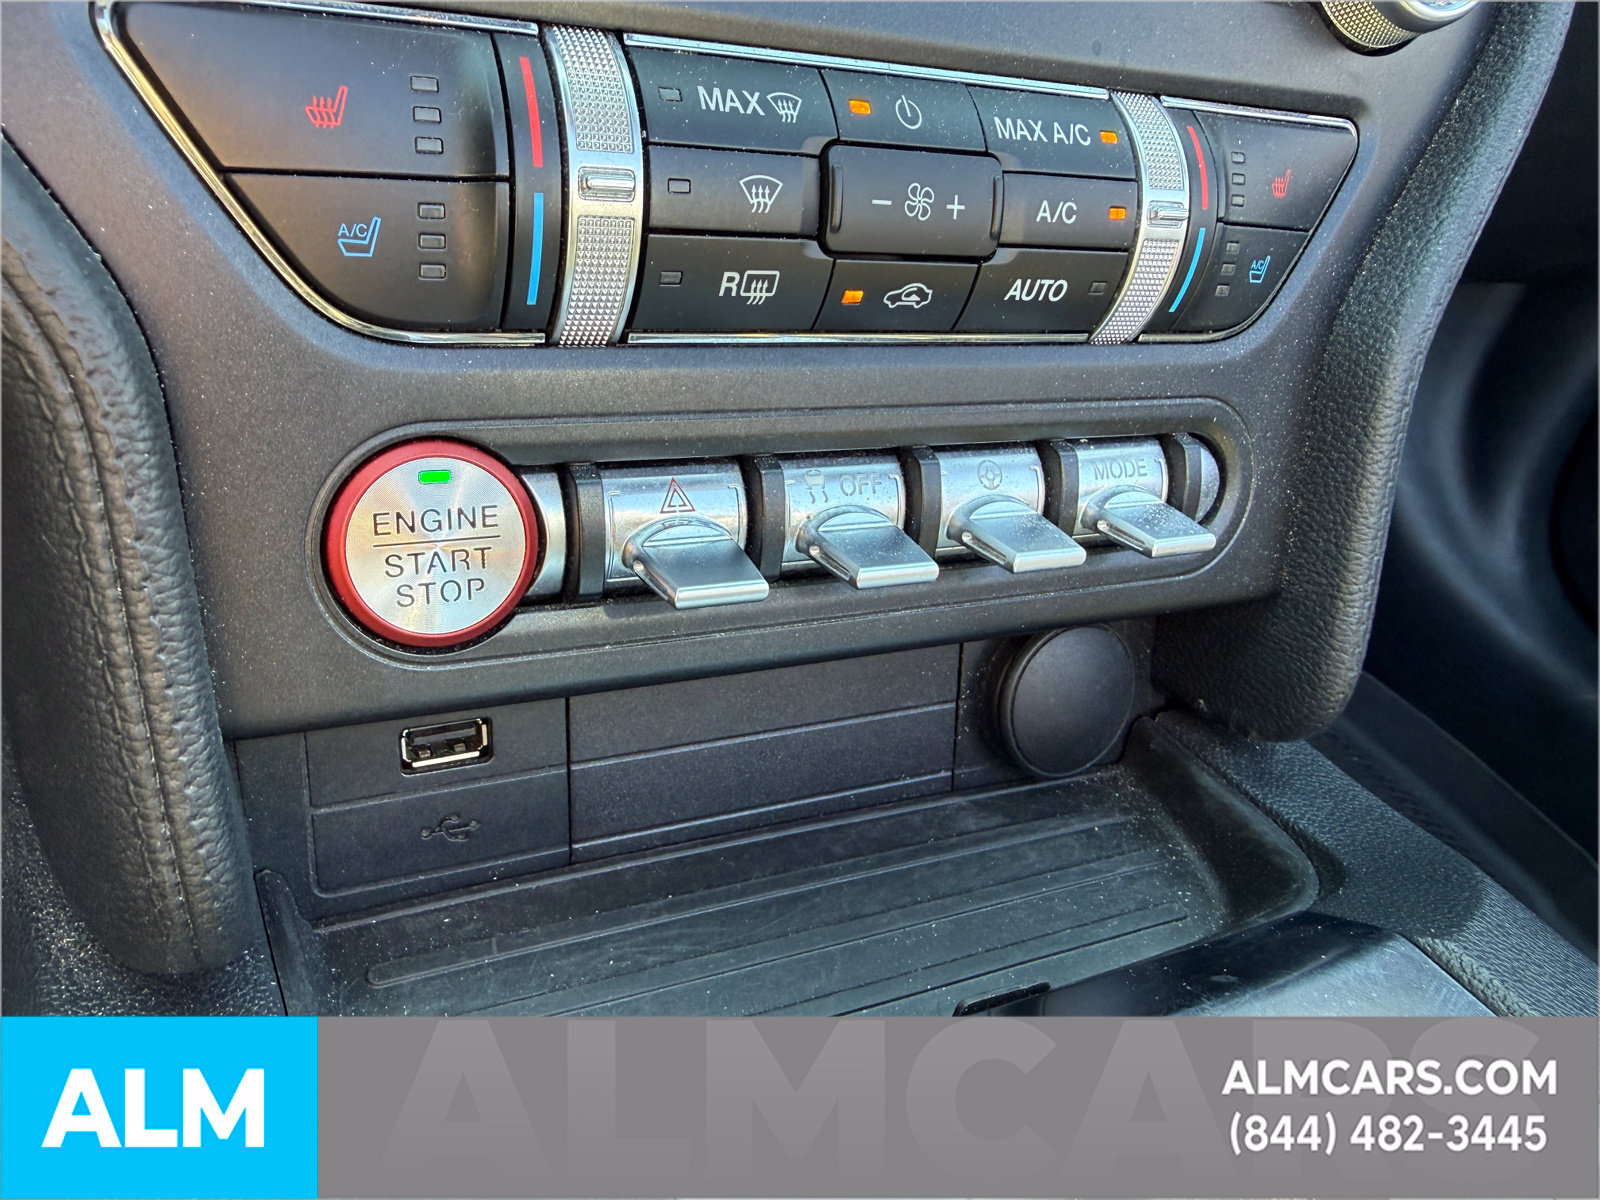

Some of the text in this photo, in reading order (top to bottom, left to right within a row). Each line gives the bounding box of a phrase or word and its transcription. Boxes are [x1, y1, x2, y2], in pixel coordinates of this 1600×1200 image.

[697, 86, 766, 116] MAX
[994, 116, 1092, 147] MAX A/C
[1036, 199, 1078, 223] A/C
[339, 224, 367, 237] A/C
[719, 272, 740, 297] R
[1003, 279, 1068, 303] AUTO
[1092, 457, 1149, 480] MODE
[839, 472, 884, 497] OFF
[373, 504, 500, 537] ENGINE
[385, 546, 493, 578] START
[396, 577, 486, 608] STOP
